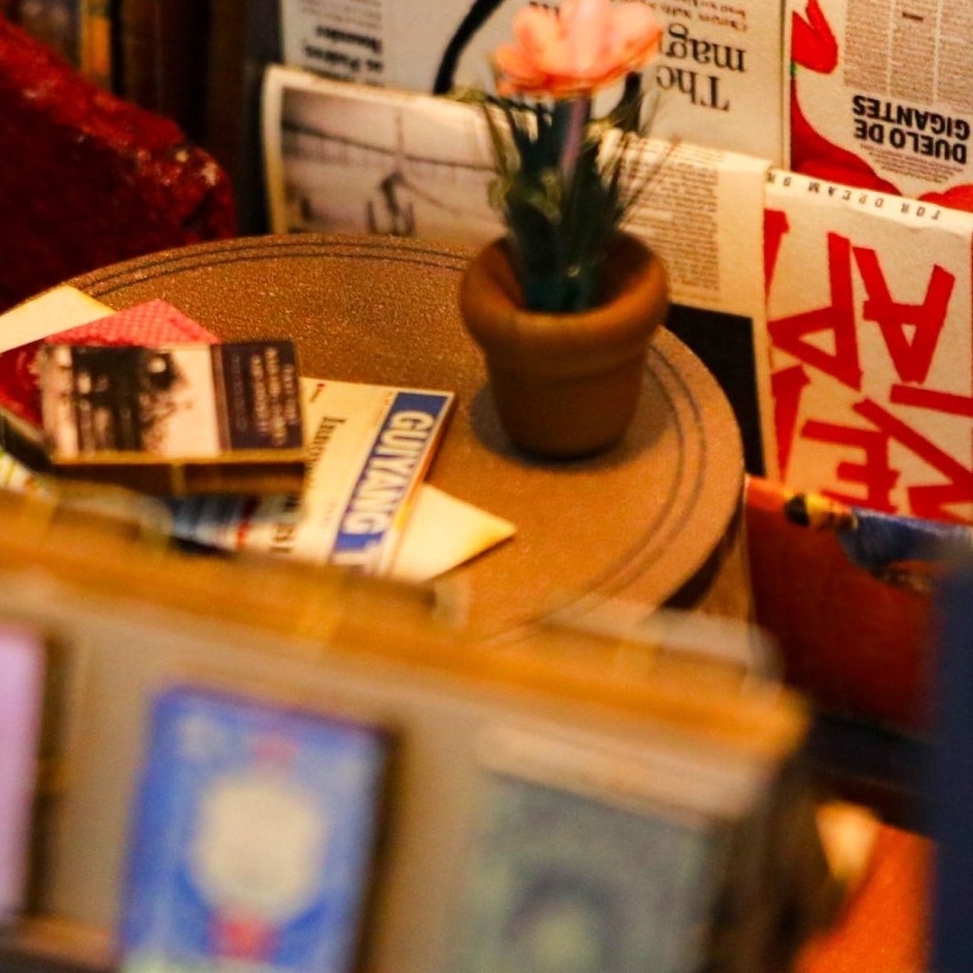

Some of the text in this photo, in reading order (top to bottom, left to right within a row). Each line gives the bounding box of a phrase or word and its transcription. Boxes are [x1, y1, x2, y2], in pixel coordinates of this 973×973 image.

[655, 65, 731, 113] The
[851, 94, 972, 142] GIGANTES
[853, 117, 885, 145] DE
[888, 126, 968, 165] DUELO
[341, 408, 438, 538] GUIYANG
